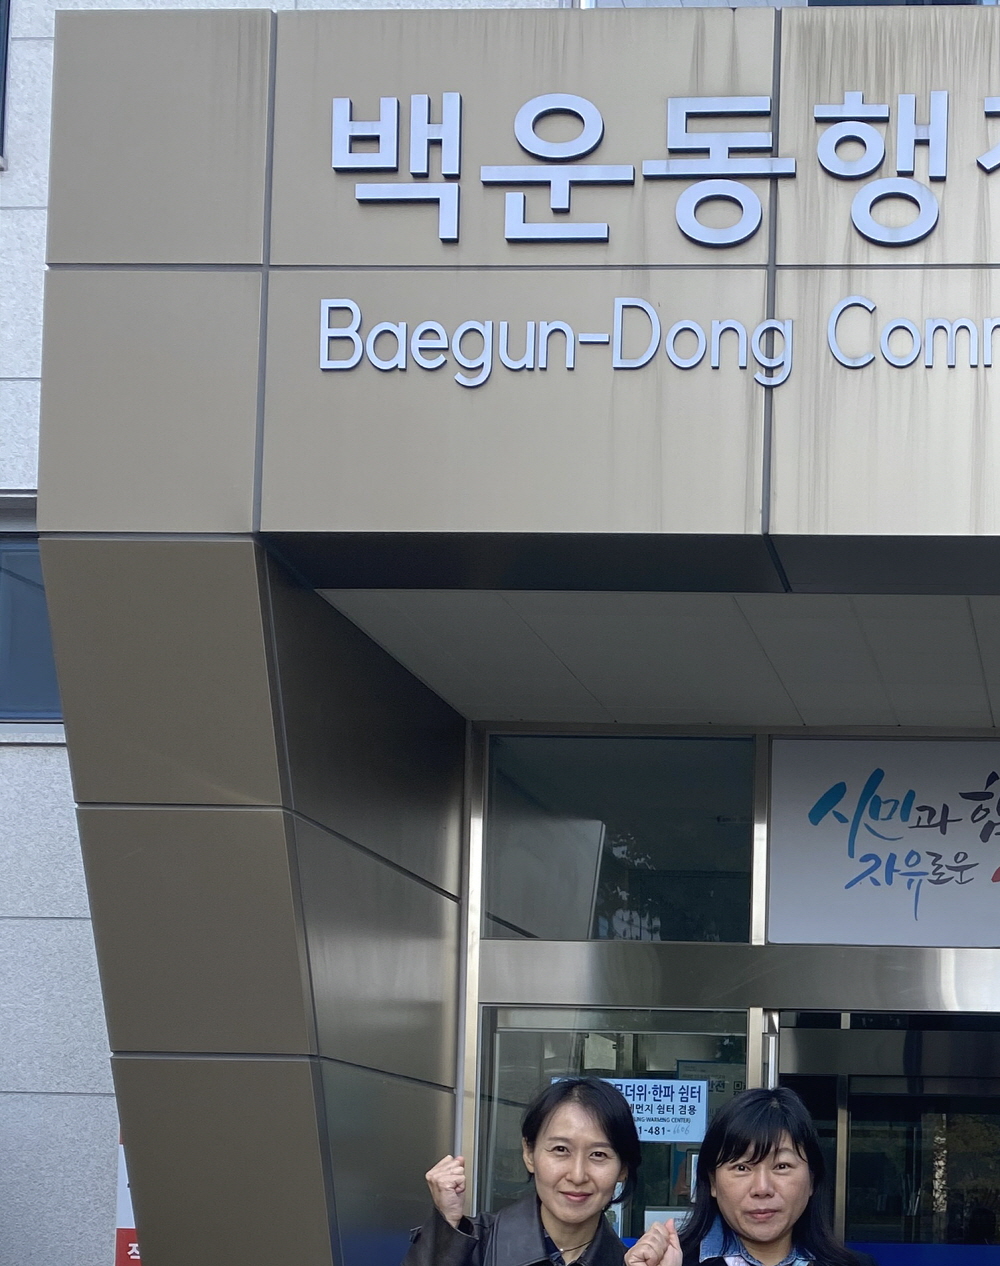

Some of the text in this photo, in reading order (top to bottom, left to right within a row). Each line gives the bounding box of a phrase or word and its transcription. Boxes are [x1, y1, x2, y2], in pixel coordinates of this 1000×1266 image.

[319, 296, 794, 387] Baegun-Dong
[808, 768, 962, 857] 시민과
[844, 849, 979, 920] 자유로운
[656, 1104, 675, 1115] 쉼터
[678, 1104, 697, 1116] 겸용
[678, 1084, 701, 1103] 쉼터
